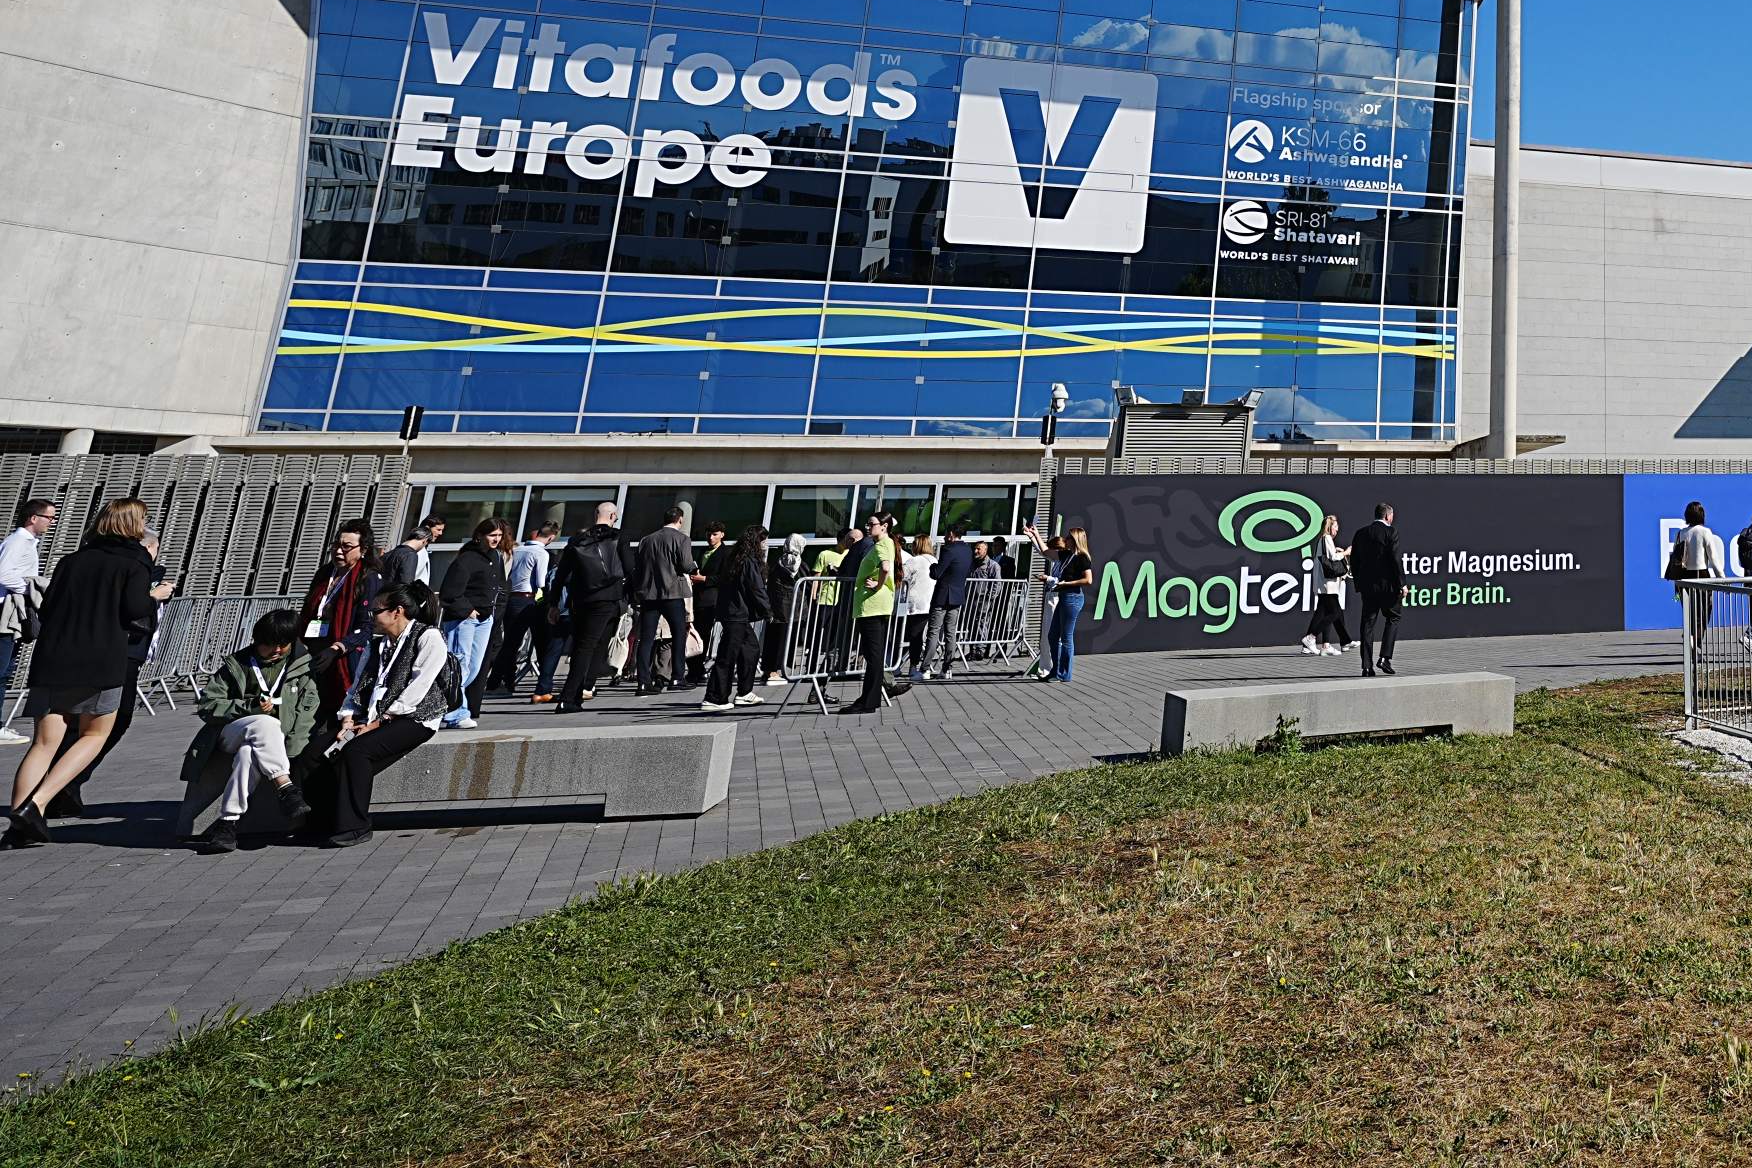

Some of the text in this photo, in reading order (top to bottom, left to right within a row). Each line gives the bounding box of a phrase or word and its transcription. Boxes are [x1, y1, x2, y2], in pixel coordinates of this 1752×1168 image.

[422, 11, 918, 121] Vitafoods
[1232, 87, 1308, 110] Flagship
[390, 94, 772, 198] Europe
[1281, 126, 1367, 152] KSM-66
[1227, 170, 1404, 191] WORLD'S BEST ASHWAGANDHA
[1275, 210, 1327, 229] SRI-81
[1273, 227, 1361, 246] Shatavari
[1220, 250, 1359, 266] WORLD'S BEST SHATAVARI
[1401, 549, 1581, 577] tter Magnesium.
[1446, 581, 1511, 605] Brain.
